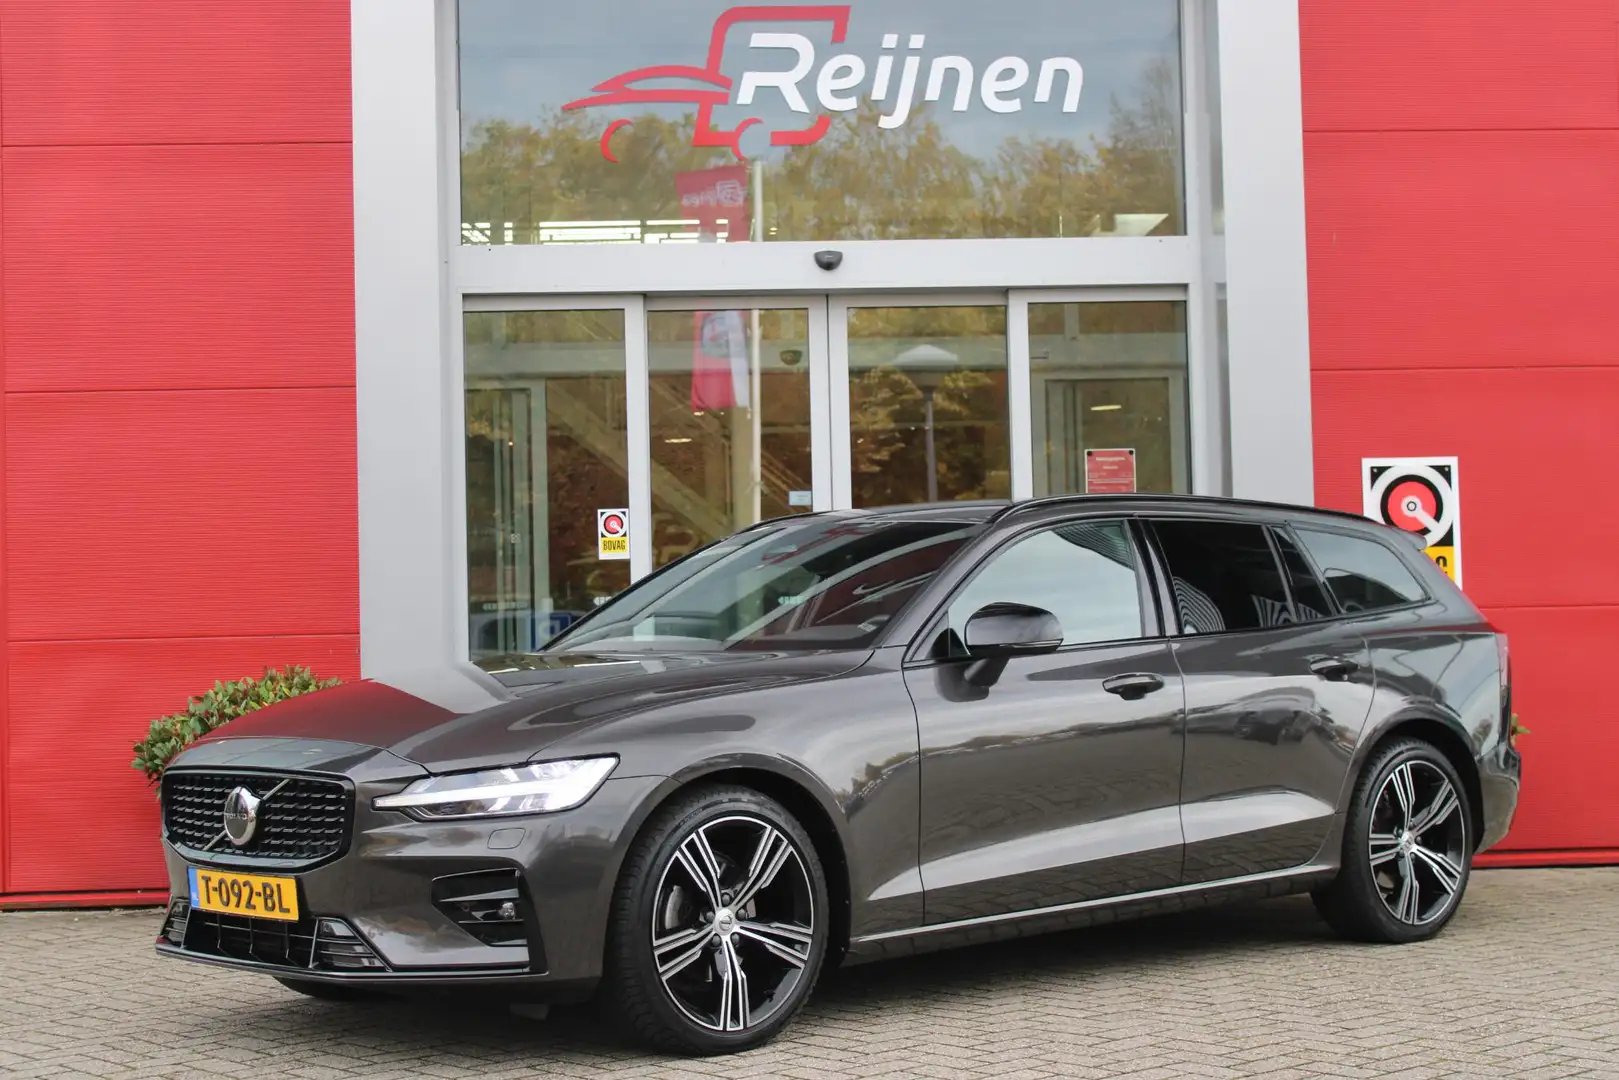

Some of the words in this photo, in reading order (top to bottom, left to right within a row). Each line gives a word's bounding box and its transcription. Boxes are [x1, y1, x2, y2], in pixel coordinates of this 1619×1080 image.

[737, 32, 1083, 128] Reijnen
[603, 540, 626, 550] BOVAG
[201, 875, 290, 913] T-092-BL
